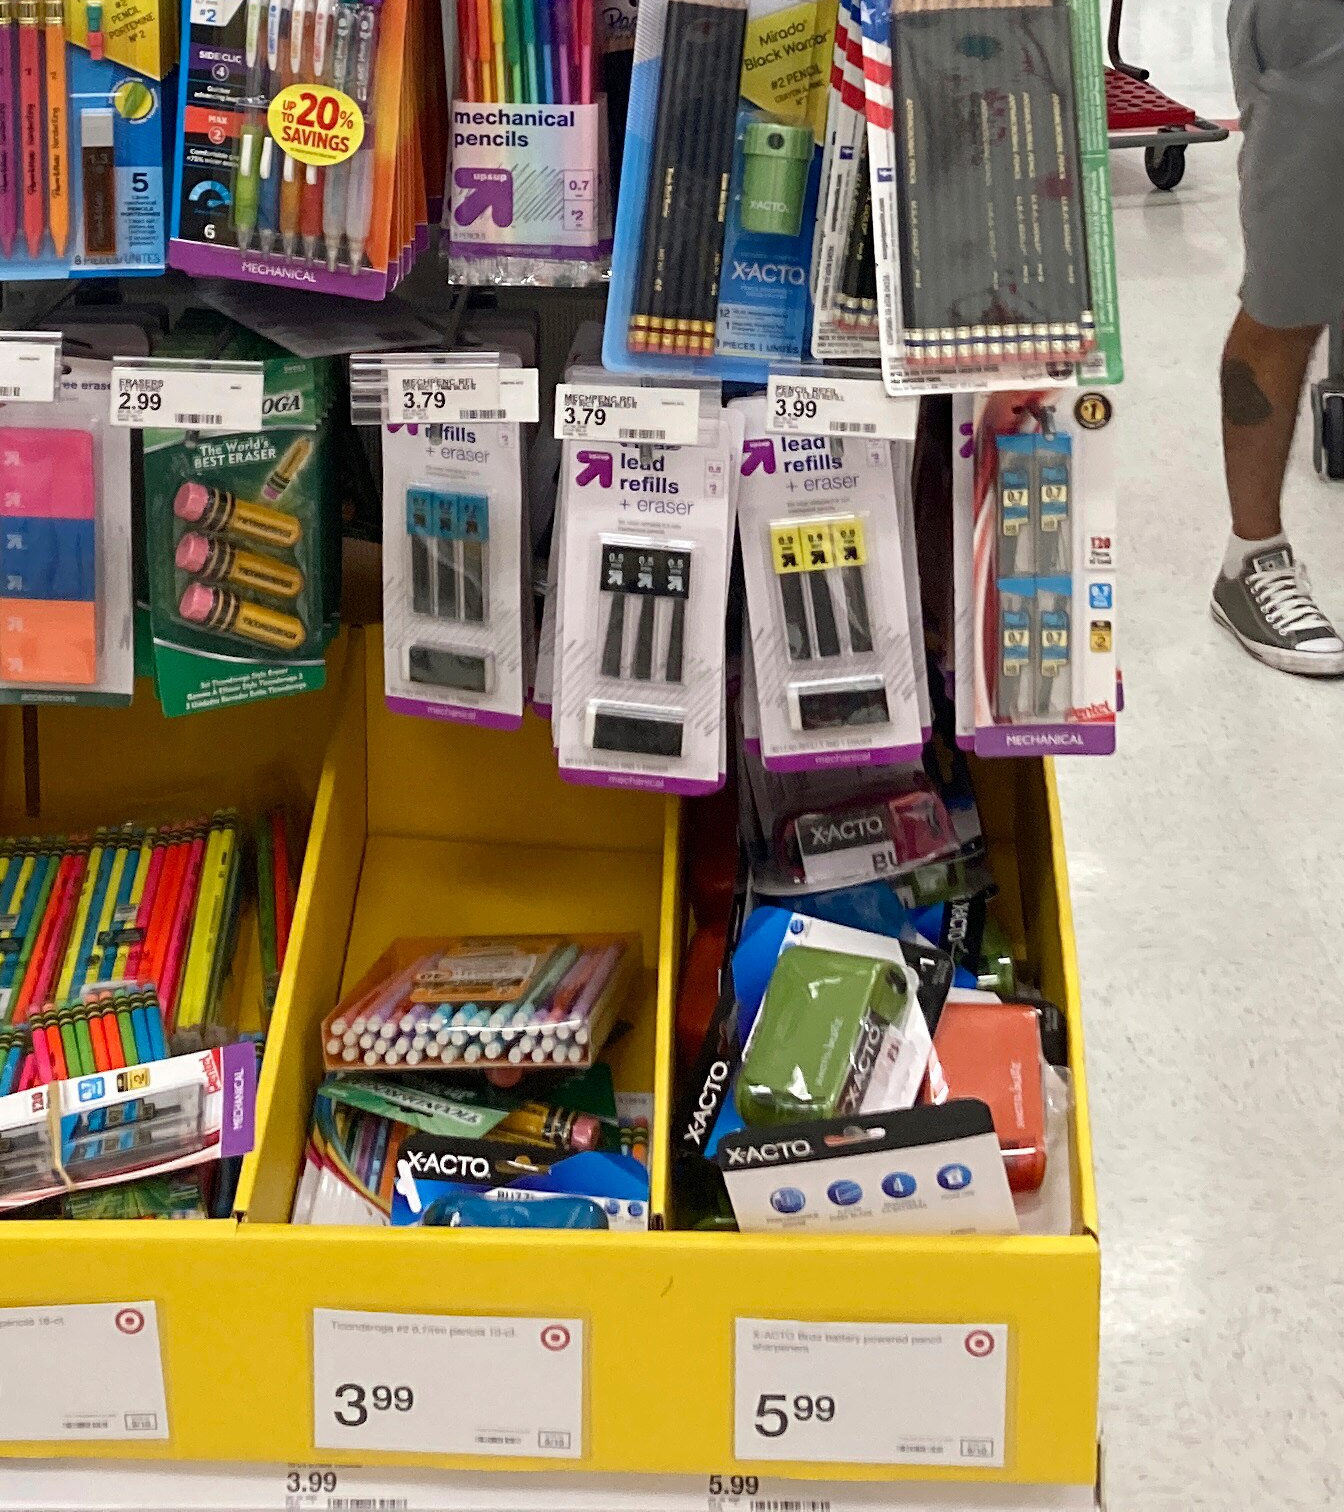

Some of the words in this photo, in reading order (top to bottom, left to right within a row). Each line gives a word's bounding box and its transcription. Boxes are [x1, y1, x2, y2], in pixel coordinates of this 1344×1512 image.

[281, 111, 295, 124] TO
[282, 100, 297, 112] UP
[296, 92, 354, 130] 20%
[454, 110, 575, 128] mechanical
[281, 126, 351, 153] SAVINGS
[454, 130, 530, 152] pencils
[132, 172, 149, 193] 5
[569, 179, 590, 193] 0.7
[241, 261, 318, 284] MECHANICAL
[731, 260, 806, 286] X-ACTO
[119, 392, 162, 412] 2.99
[403, 392, 446, 409] 3.79
[775, 399, 818, 418] 3.99
[564, 407, 607, 426] 3.79
[194, 455, 226, 470] BEST
[227, 446, 277, 466] ERASER
[199, 445, 224, 458] The
[440, 447, 491, 465] eraser
[783, 452, 844, 474] refills
[618, 475, 680, 496] refills
[803, 474, 861, 492] eraser
[636, 498, 695, 517] eraser
[1006, 731, 1084, 747] MECHANICAL
[809, 816, 884, 845] X-ACTO
[684, 1059, 731, 1144] X-ACTO
[725, 1138, 812, 1166] X-ACTO
[404, 1150, 491, 1179] X-ACTO
[333, 1383, 414, 1427] 399
[754, 1393, 836, 1438] 599
[286, 1471, 338, 1494] 3.99
[708, 1474, 760, 1496] 5.99
